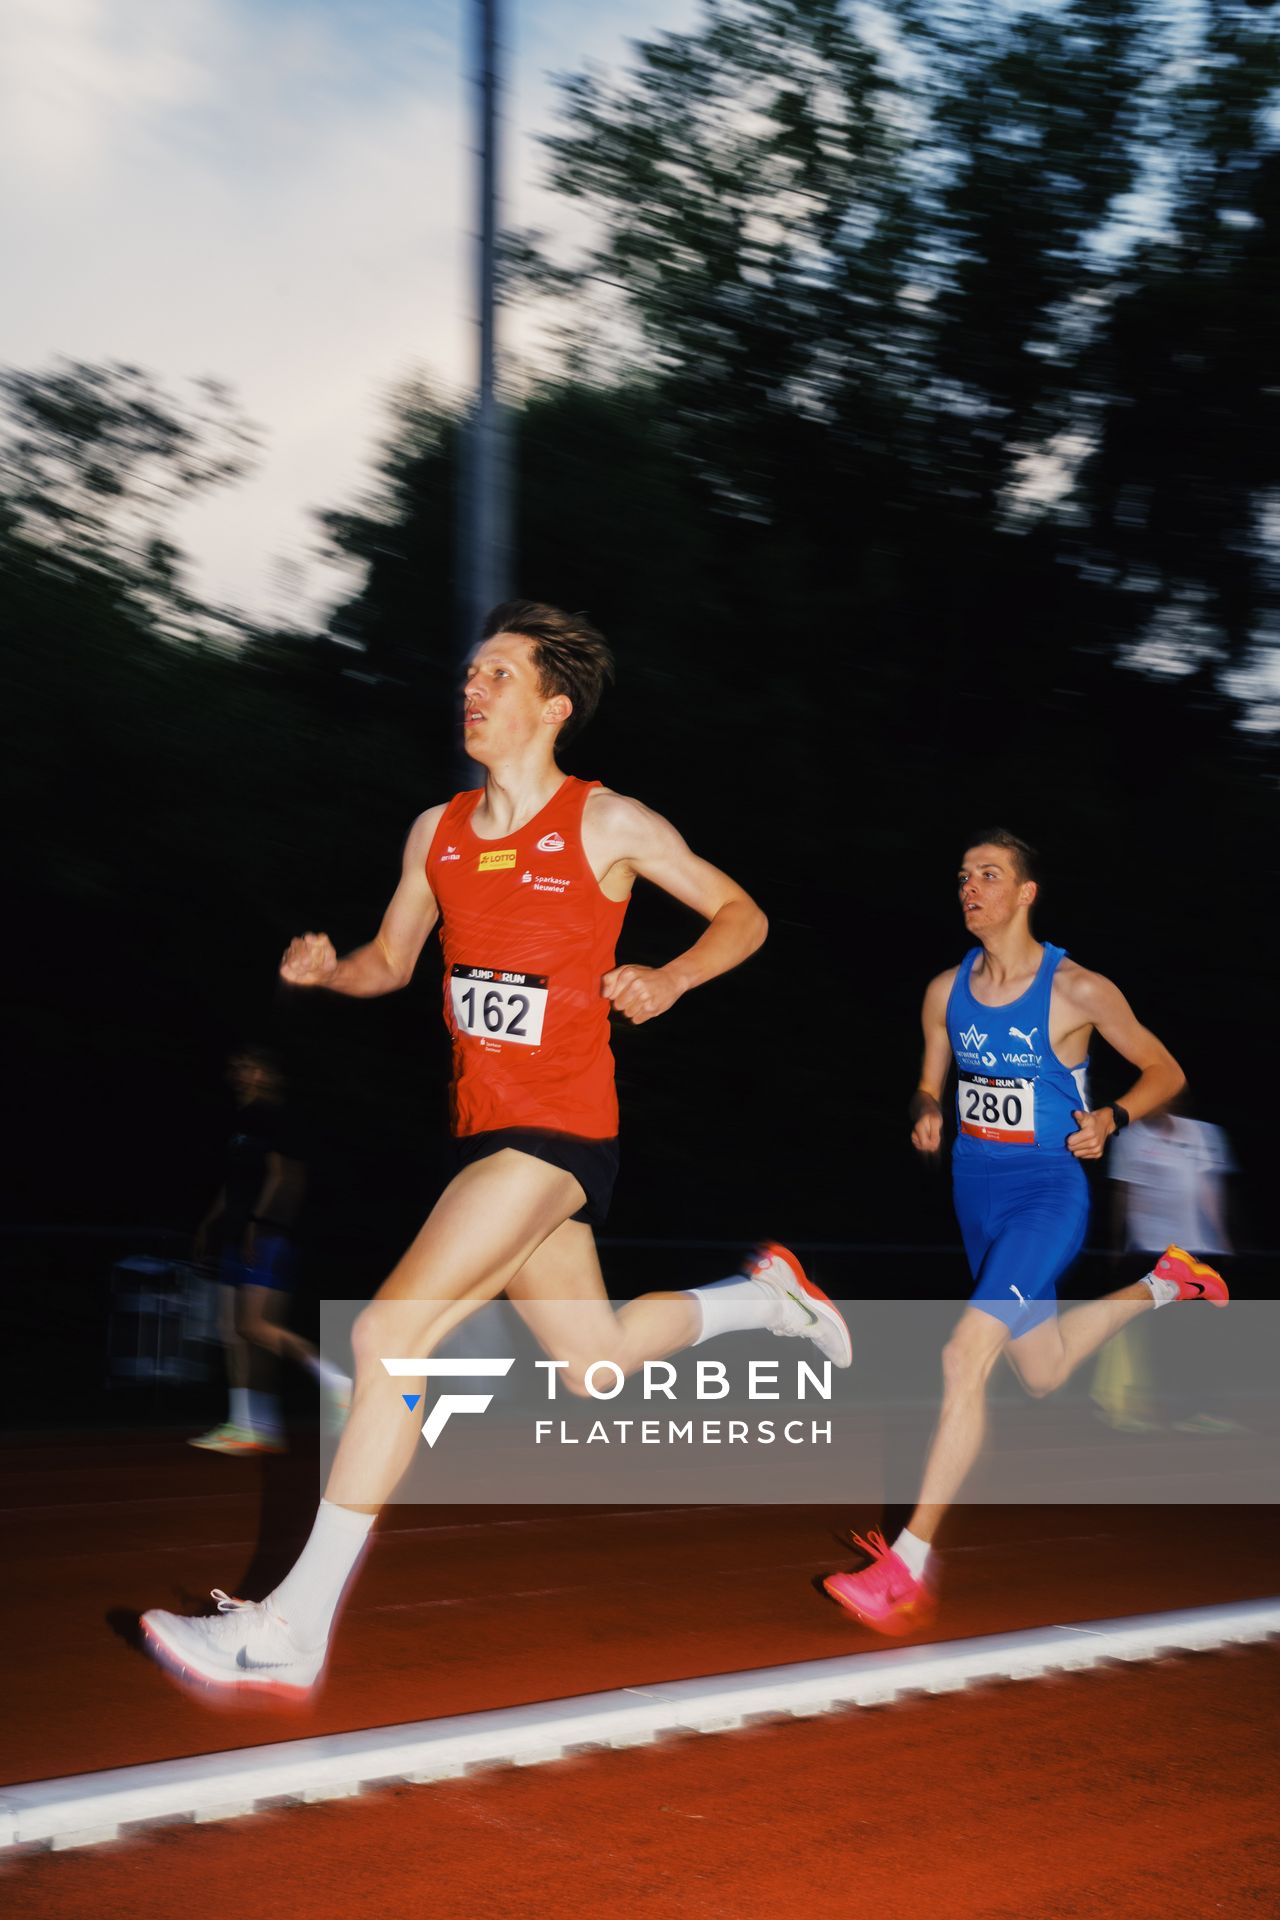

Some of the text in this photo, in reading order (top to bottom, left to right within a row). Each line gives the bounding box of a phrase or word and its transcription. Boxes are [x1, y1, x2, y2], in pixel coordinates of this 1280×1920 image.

[490, 853, 516, 863] LOTTO
[535, 875, 571, 886] Sparkasse
[533, 883, 565, 893] Neuwied
[461, 986, 531, 1037] 162
[965, 1088, 1022, 1126] 280
